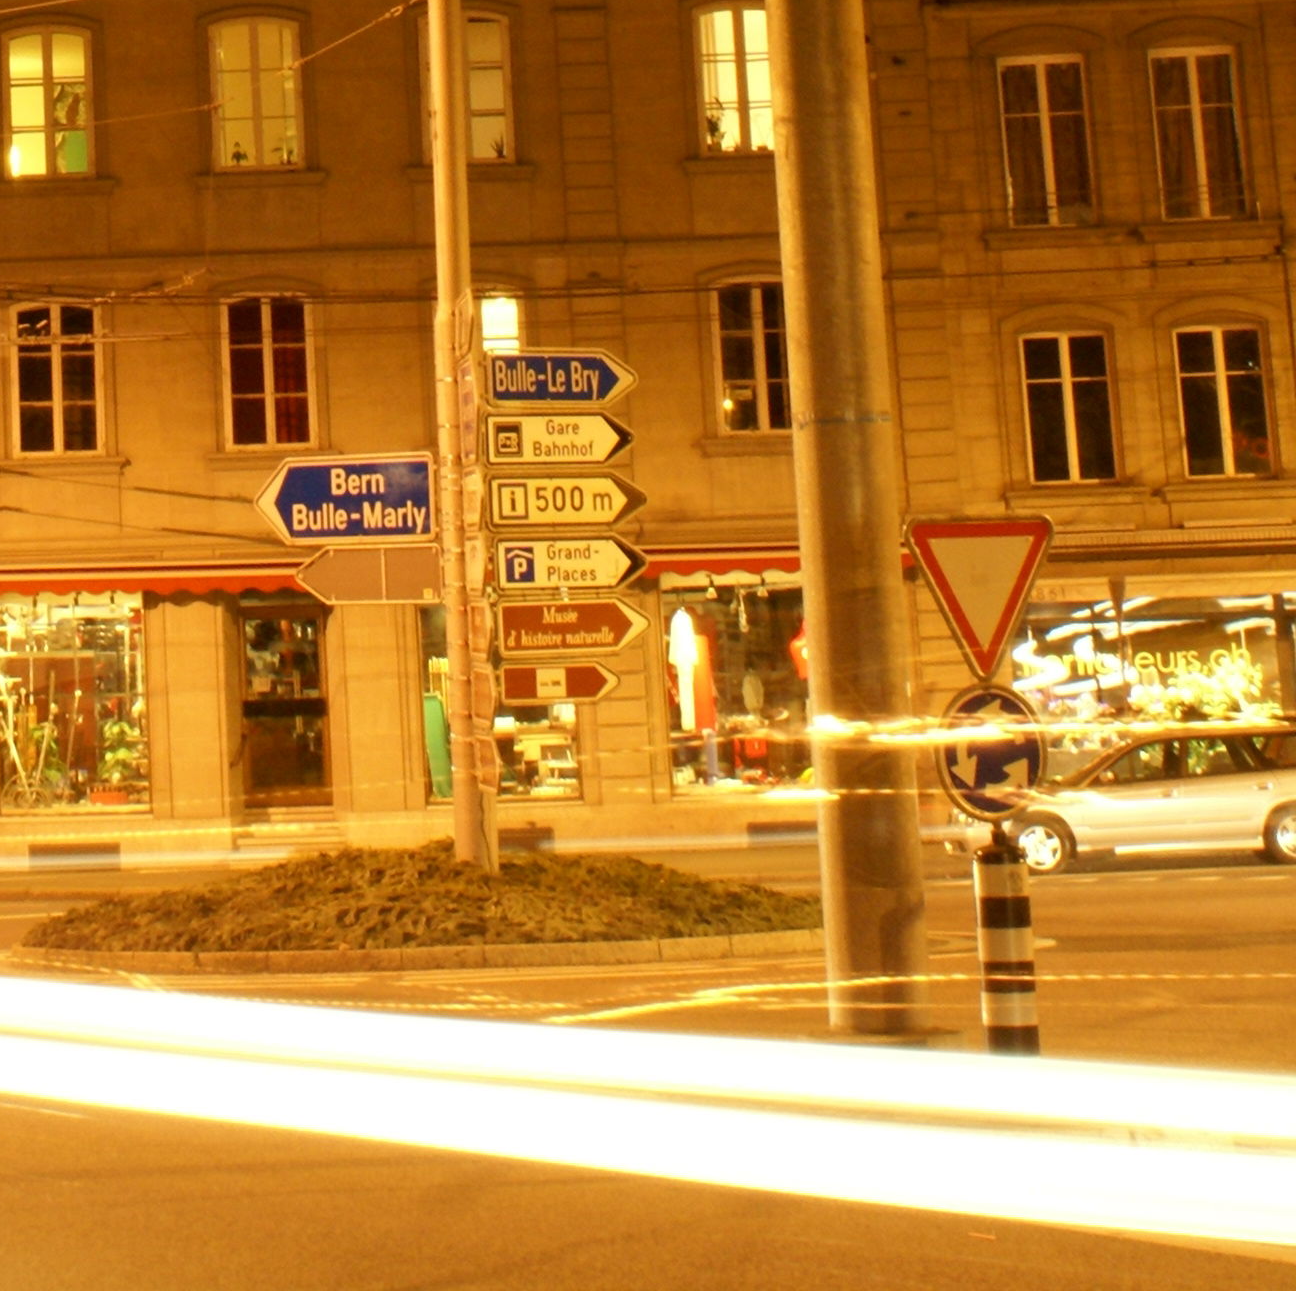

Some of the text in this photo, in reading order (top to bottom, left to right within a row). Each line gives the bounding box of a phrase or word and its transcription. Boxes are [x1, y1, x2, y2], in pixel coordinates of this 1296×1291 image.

[494, 360, 600, 400] Bulle-Le Bry
[546, 419, 580, 435] Gare
[532, 440, 593, 457] Bahnhof
[330, 468, 385, 496] Bern
[535, 485, 584, 512] 500
[592, 492, 613, 512] m
[292, 500, 426, 534] Bulle-Marly
[546, 544, 600, 560] Grand-
[547, 566, 598, 582] Places
[542, 606, 578, 624] Musée
[521, 629, 562, 647] histoire
[565, 625, 615, 645] naturelle
